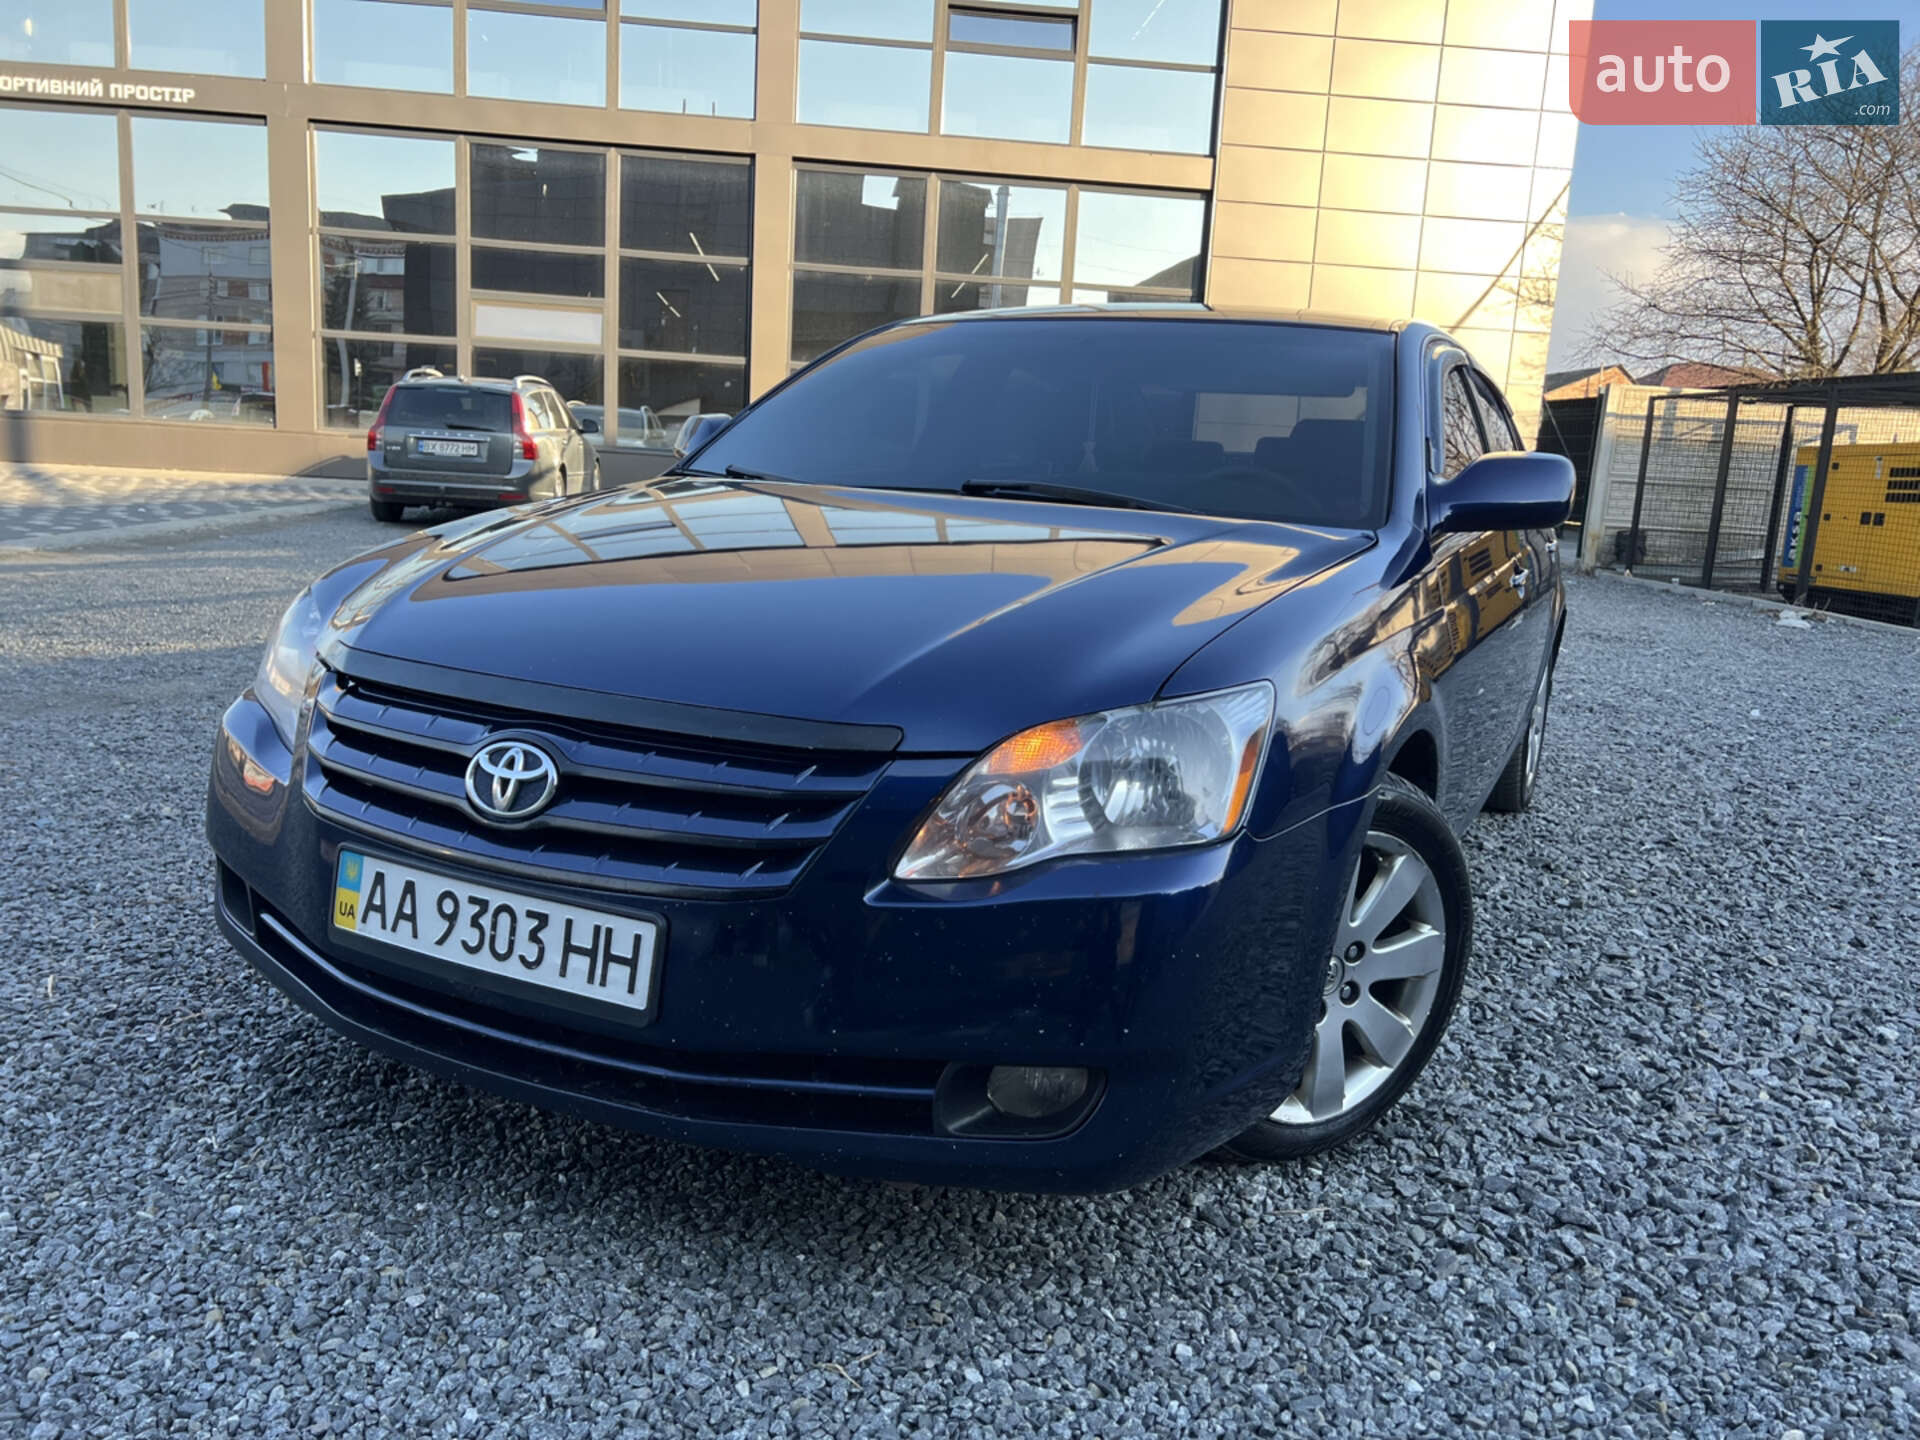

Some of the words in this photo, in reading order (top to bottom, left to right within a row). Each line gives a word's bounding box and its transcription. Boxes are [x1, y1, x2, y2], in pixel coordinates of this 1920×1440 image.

[0, 75, 103, 97] ОРТИВНИЙ
[110, 83, 195, 103] ПРОСТІР
[338, 901, 356, 920] UA
[361, 871, 418, 939] AA
[434, 889, 549, 970] 9303
[559, 918, 642, 994] HH
